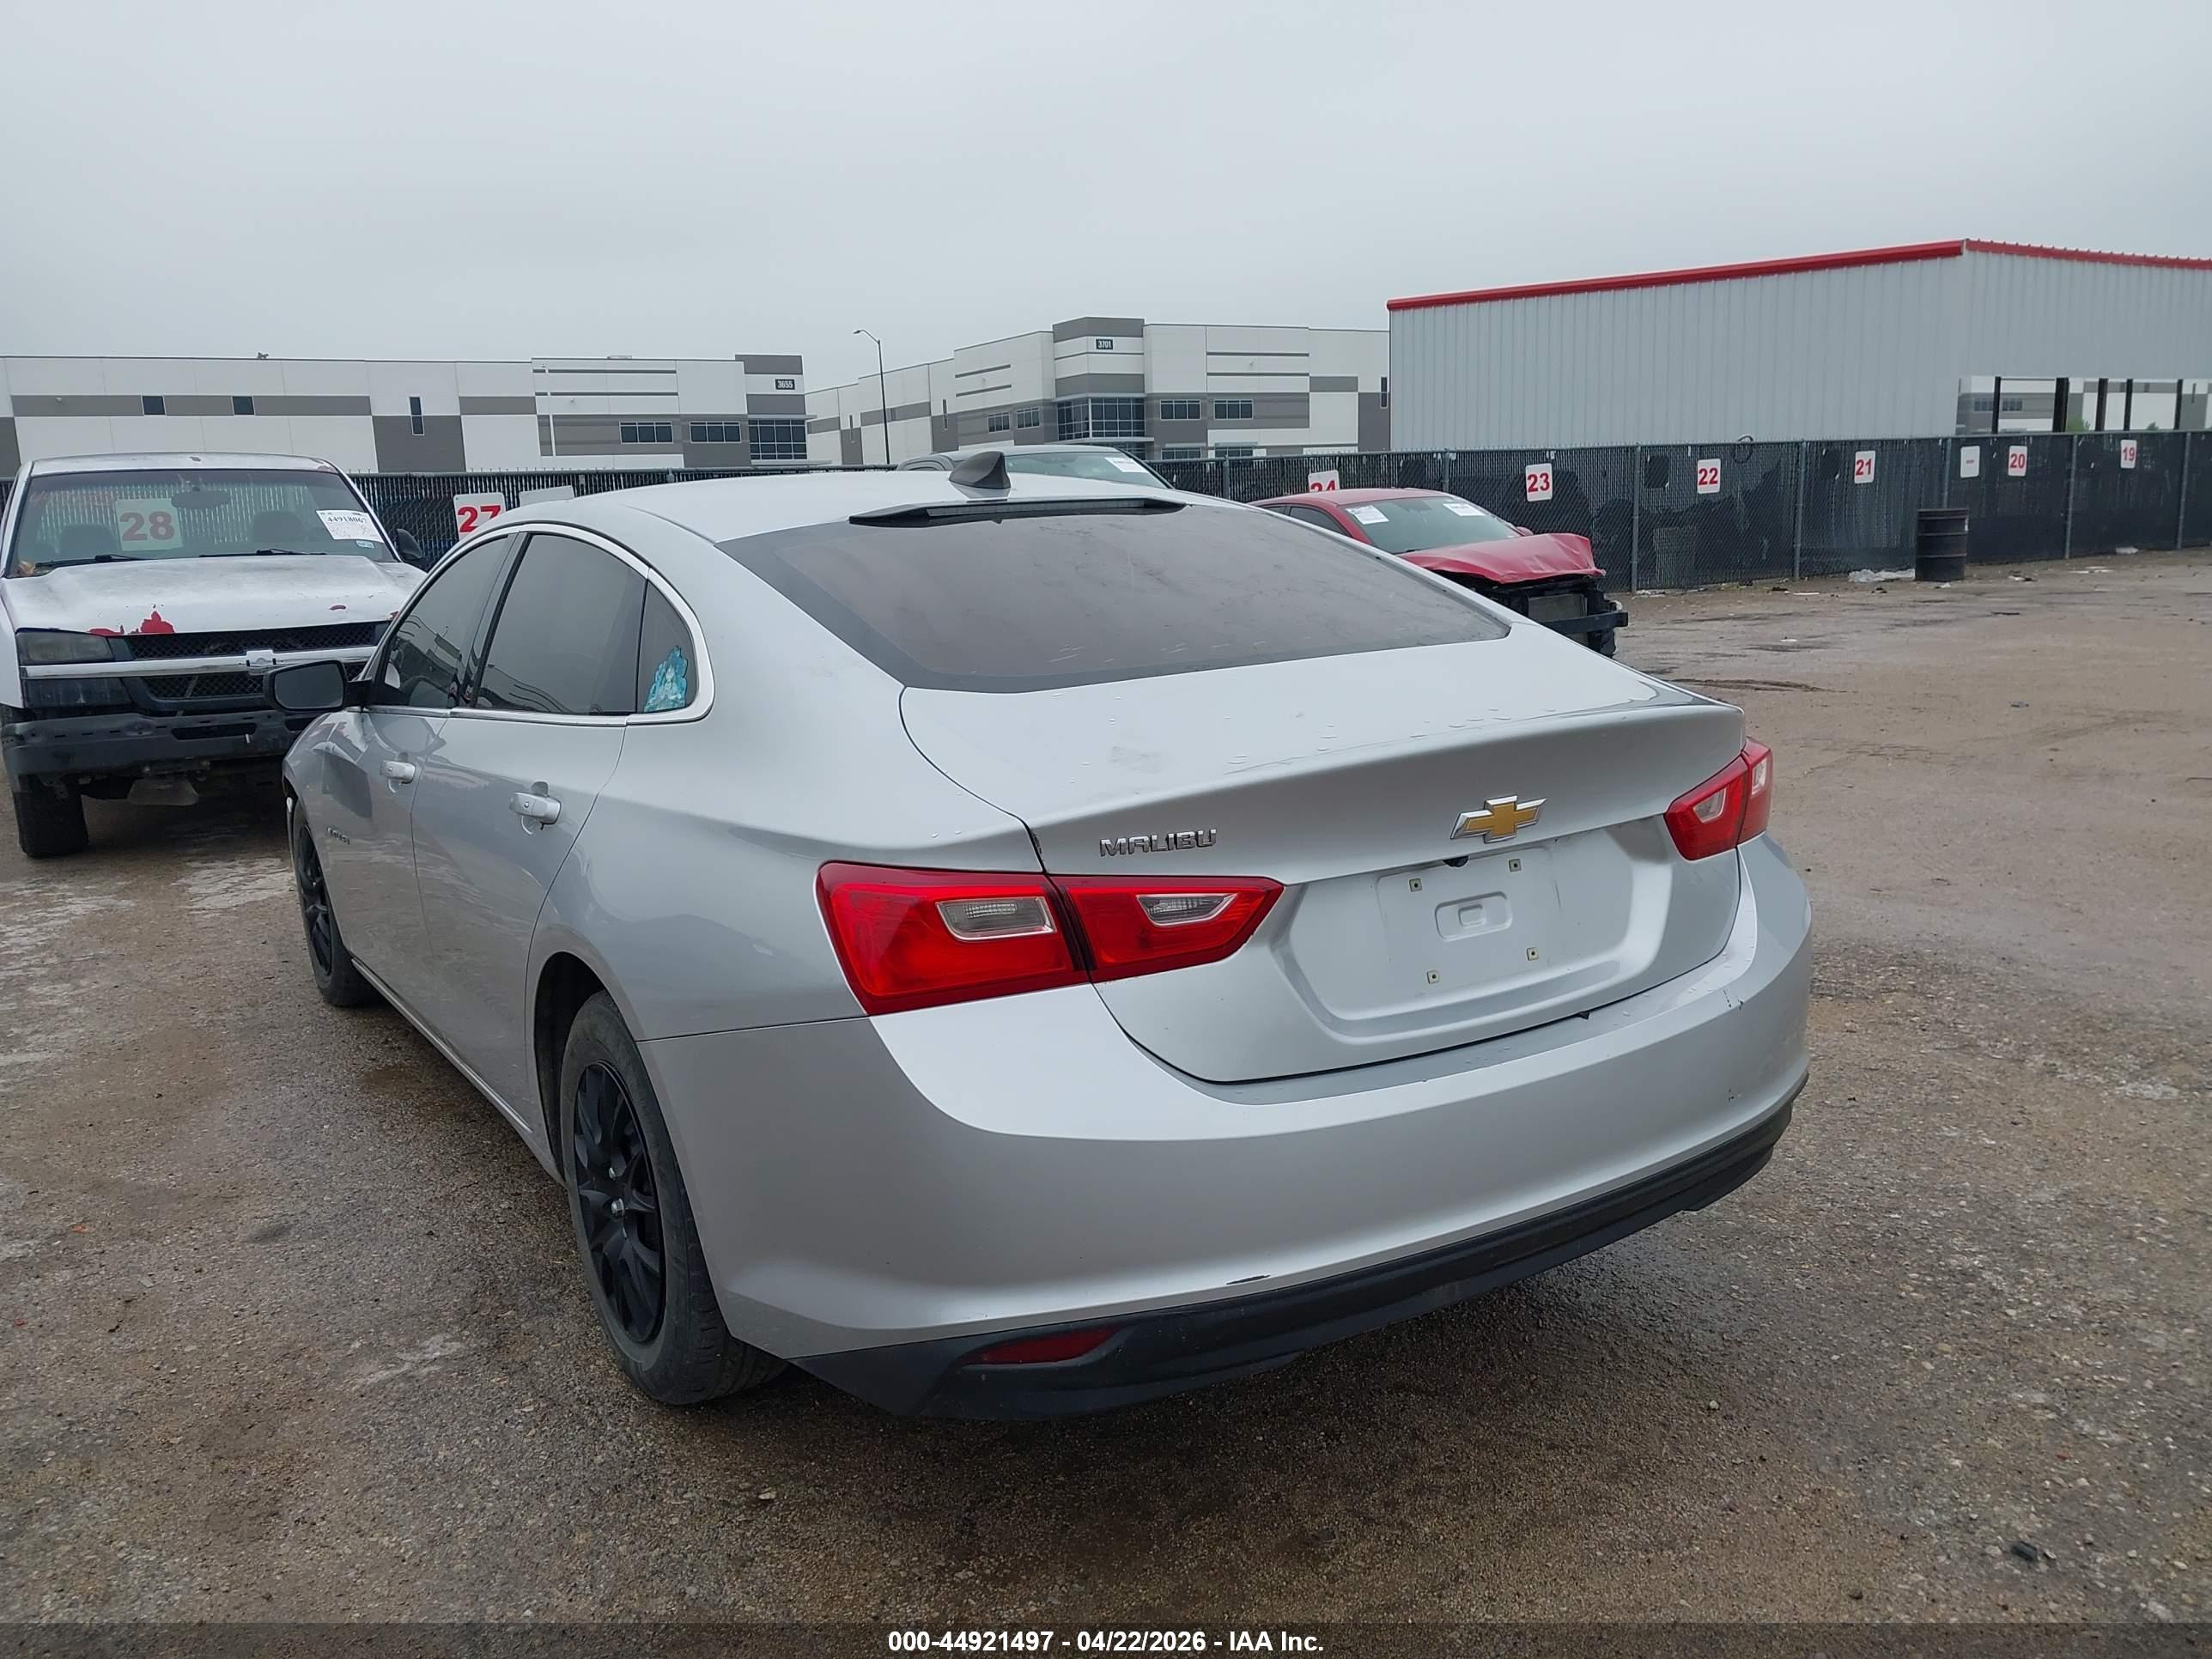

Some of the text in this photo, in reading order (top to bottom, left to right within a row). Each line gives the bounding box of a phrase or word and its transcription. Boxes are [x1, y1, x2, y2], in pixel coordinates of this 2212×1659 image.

[1097, 340, 1111, 349] 3701
[2010, 453, 2026, 469] 20
[2123, 447, 2135, 461] 19
[1698, 467, 1718, 485] 22
[1856, 459, 1872, 476] 21
[1527, 472, 1551, 493] 23
[119, 511, 175, 542] 28
[457, 504, 501, 533] 27
[1099, 829, 1217, 857] MALIBU
